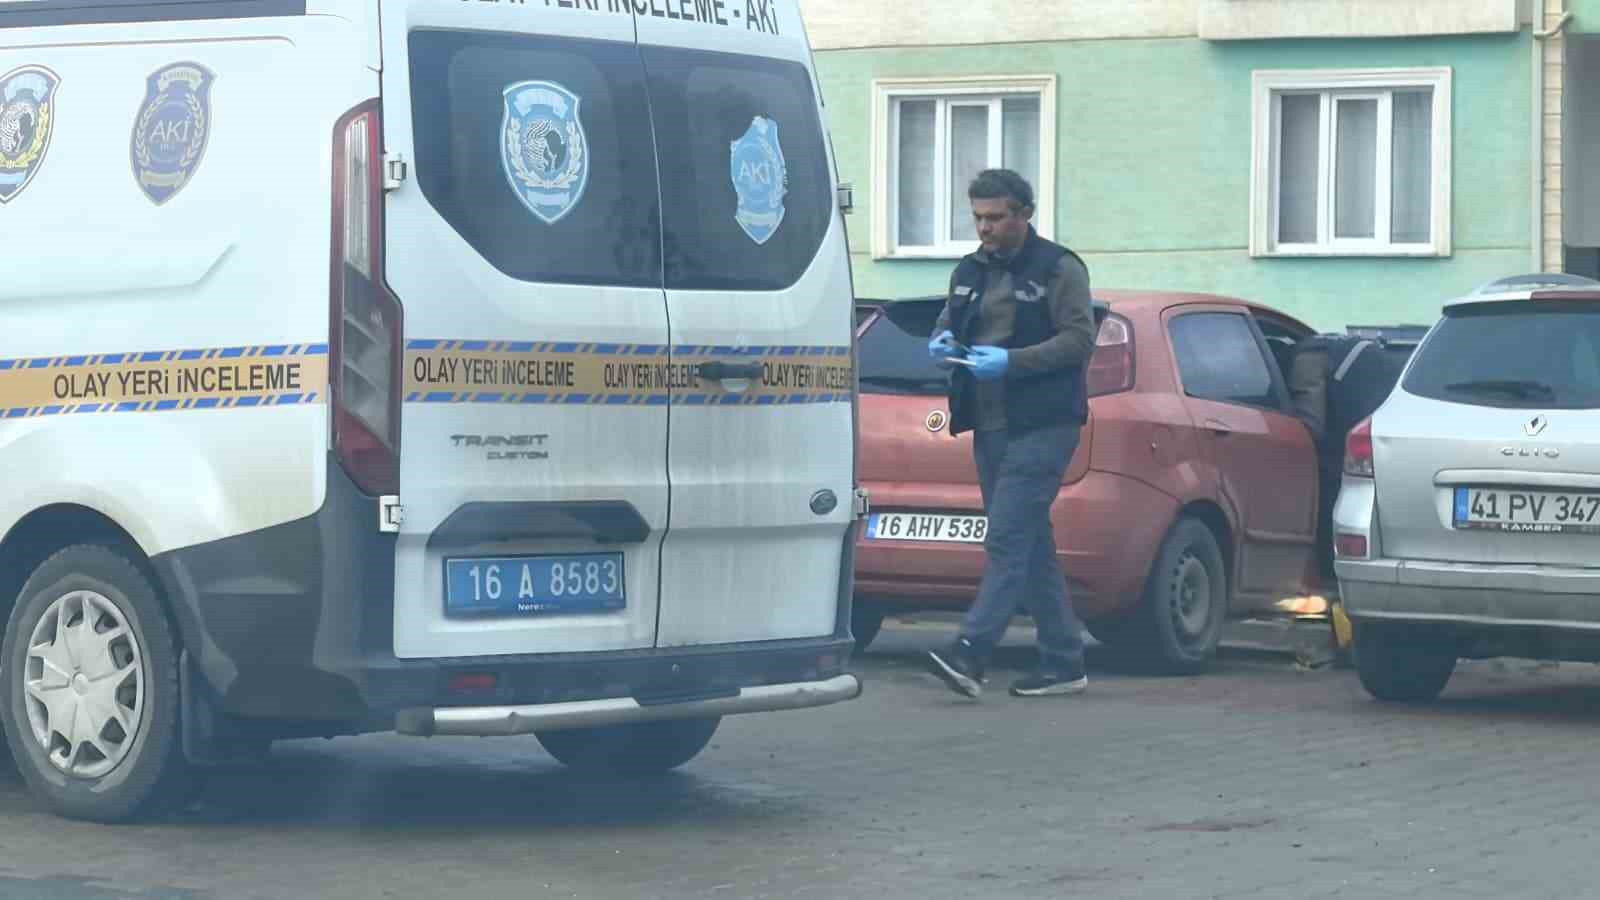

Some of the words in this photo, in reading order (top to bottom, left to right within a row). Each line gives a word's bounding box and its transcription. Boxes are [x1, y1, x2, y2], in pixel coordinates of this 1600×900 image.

[413, 356, 459, 384] OLAY
[604, 363, 630, 388] OLAY
[762, 362, 790, 388] OLAY
[54, 372, 111, 399] OLAY
[450, 434, 549, 447] TRANSIT
[1500, 446, 1561, 458] CLIO
[1471, 491, 1500, 519] 41
[1509, 493, 1546, 521] PV
[1555, 495, 1600, 522] 347
[880, 515, 902, 537] 16
[906, 516, 945, 537] AHV
[948, 518, 986, 539] 538
[1501, 523, 1562, 532] KAMBER
[469, 565, 502, 601] 16
[519, 563, 534, 599] A
[550, 559, 617, 596] 8583
